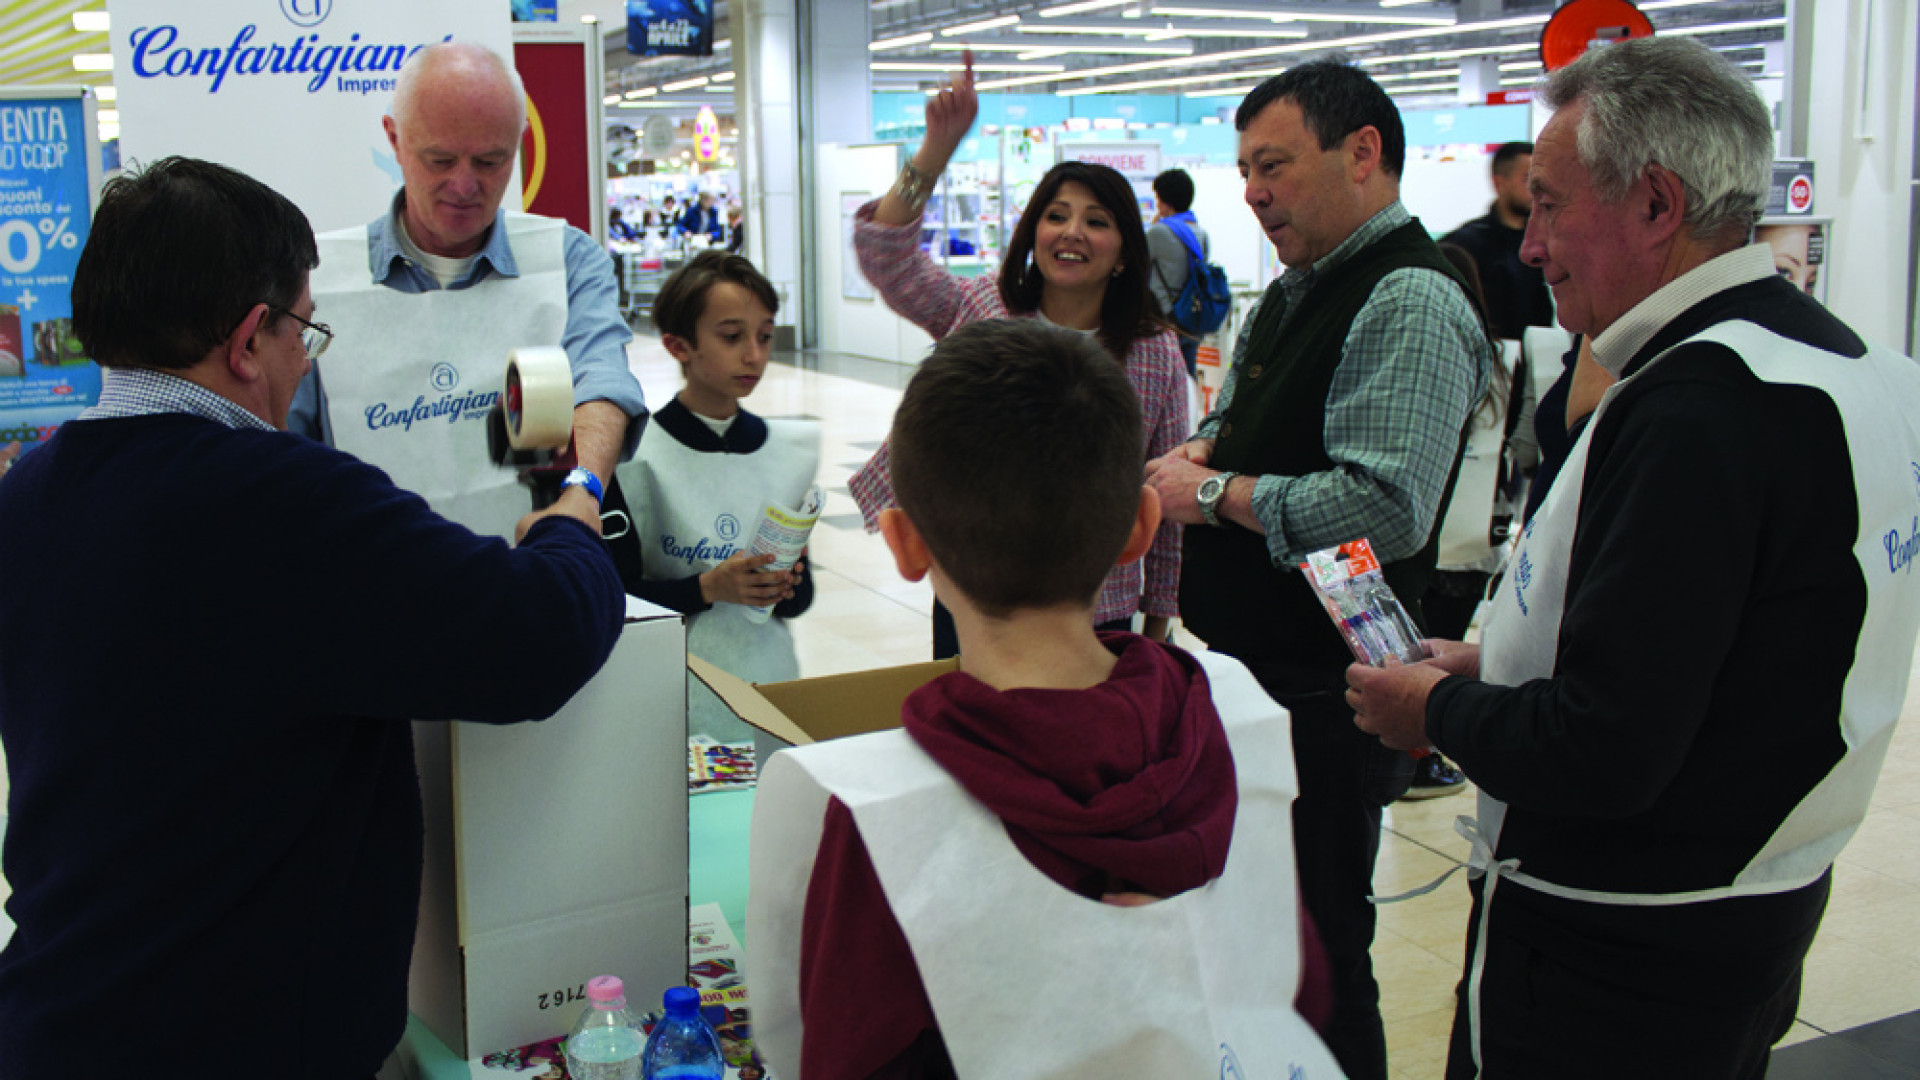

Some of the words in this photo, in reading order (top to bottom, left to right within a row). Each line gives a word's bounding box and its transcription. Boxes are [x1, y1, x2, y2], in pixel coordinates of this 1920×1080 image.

[129, 25, 453, 93] Confartigian
[337, 76, 397, 95] Impres
[0, 106, 68, 143] ENTA
[364, 389, 500, 432] Confartigian
[660, 534, 742, 564] Confarti
[538, 983, 586, 1010] 7162
